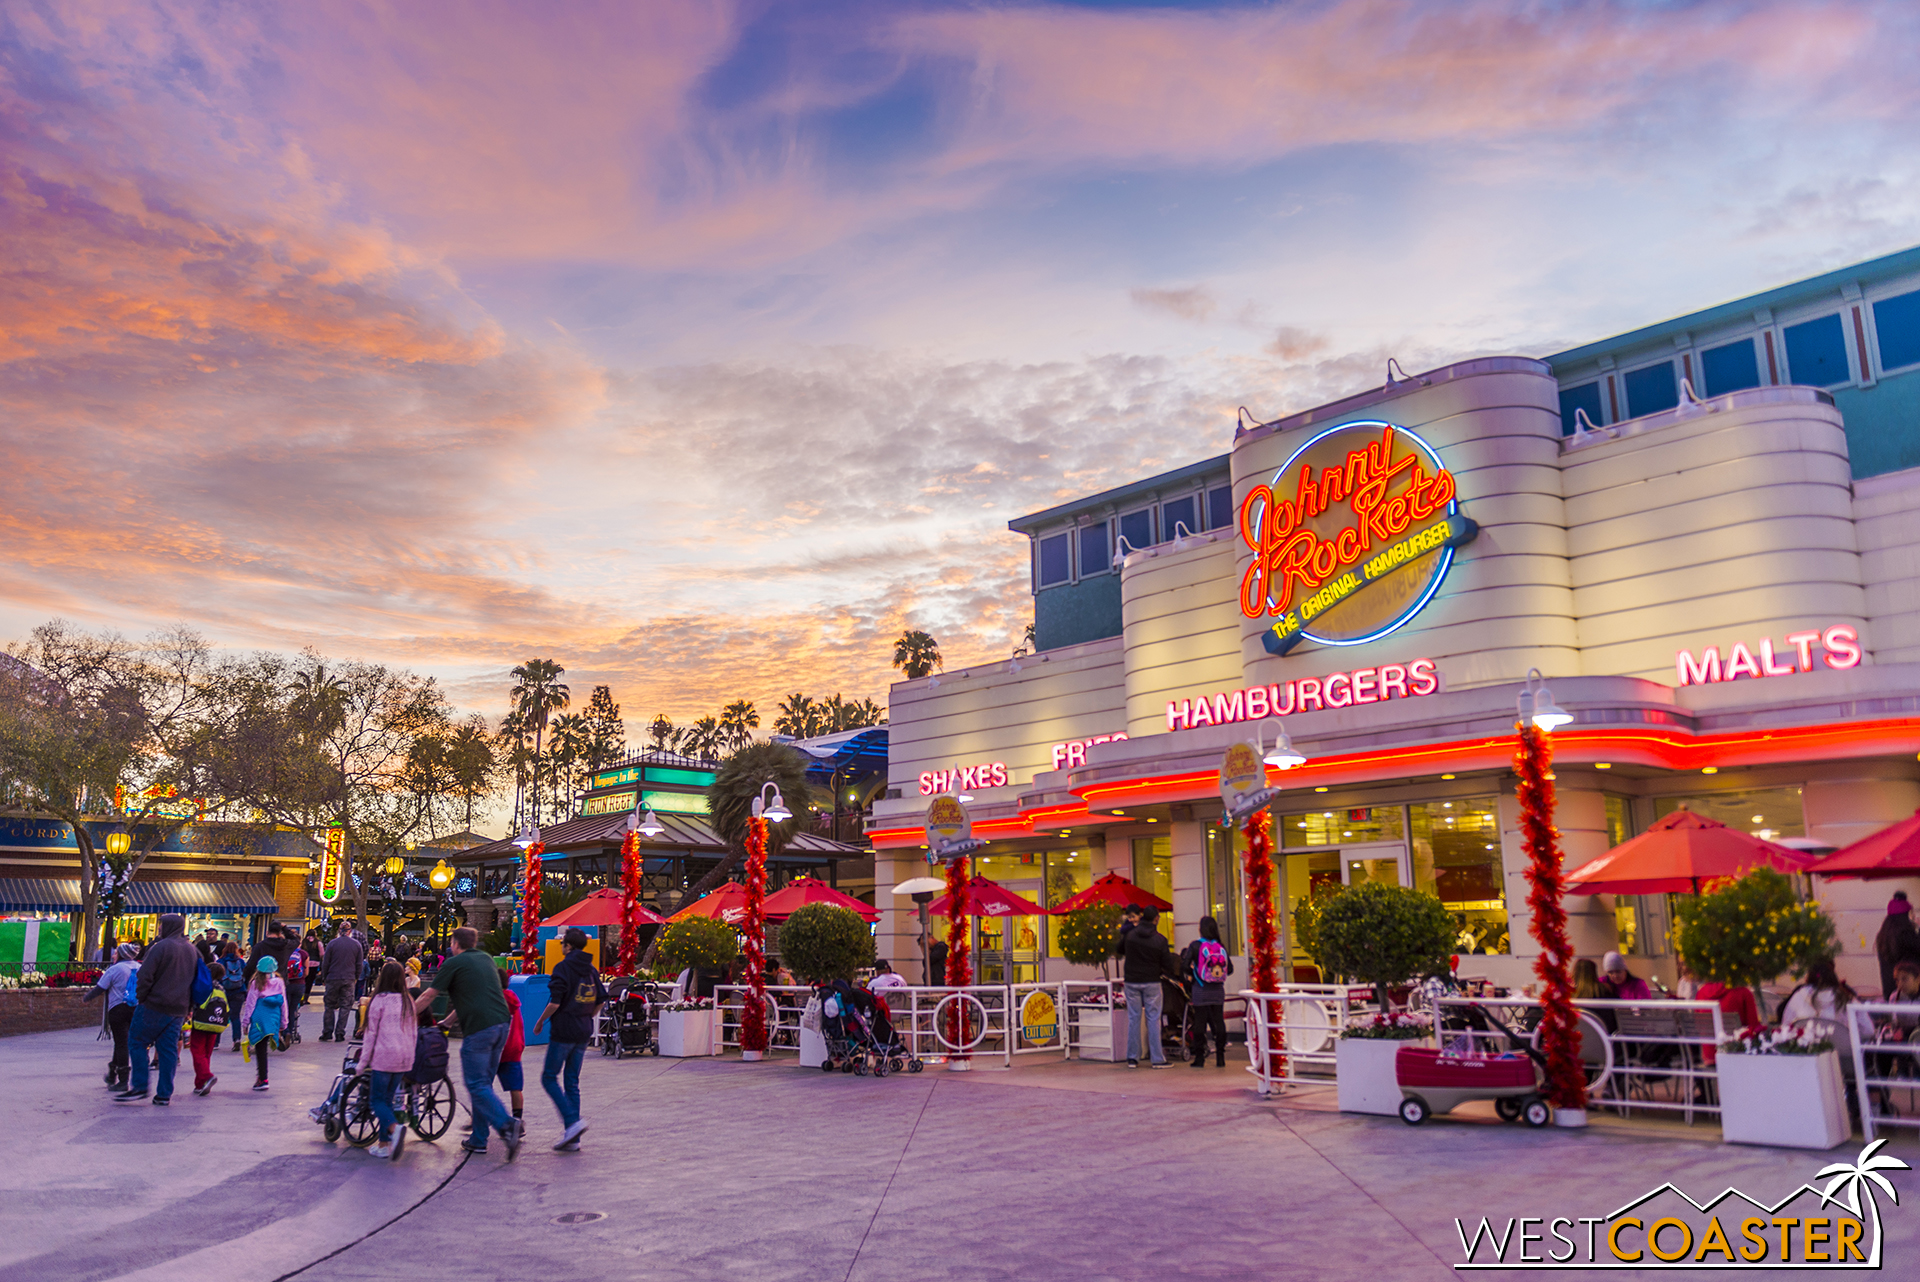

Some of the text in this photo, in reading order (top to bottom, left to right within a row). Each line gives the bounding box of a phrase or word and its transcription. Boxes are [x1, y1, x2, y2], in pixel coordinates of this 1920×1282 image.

[1240, 425, 1416, 618] Johnny
[1268, 467, 1456, 617] Rockets
[1272, 520, 1451, 639] THE ORIGINAL HAMBURGER
[1675, 624, 1862, 687] MALTS
[1166, 658, 1439, 731] HAMBURGERS
[586, 792, 633, 816] IRON REEF
[594, 768, 639, 788] Voyage to the
[11, 827, 76, 839] CORDY'
[325, 831, 340, 887] GIFTS
[1026, 1025, 1054, 1038] EXIT ONLY
